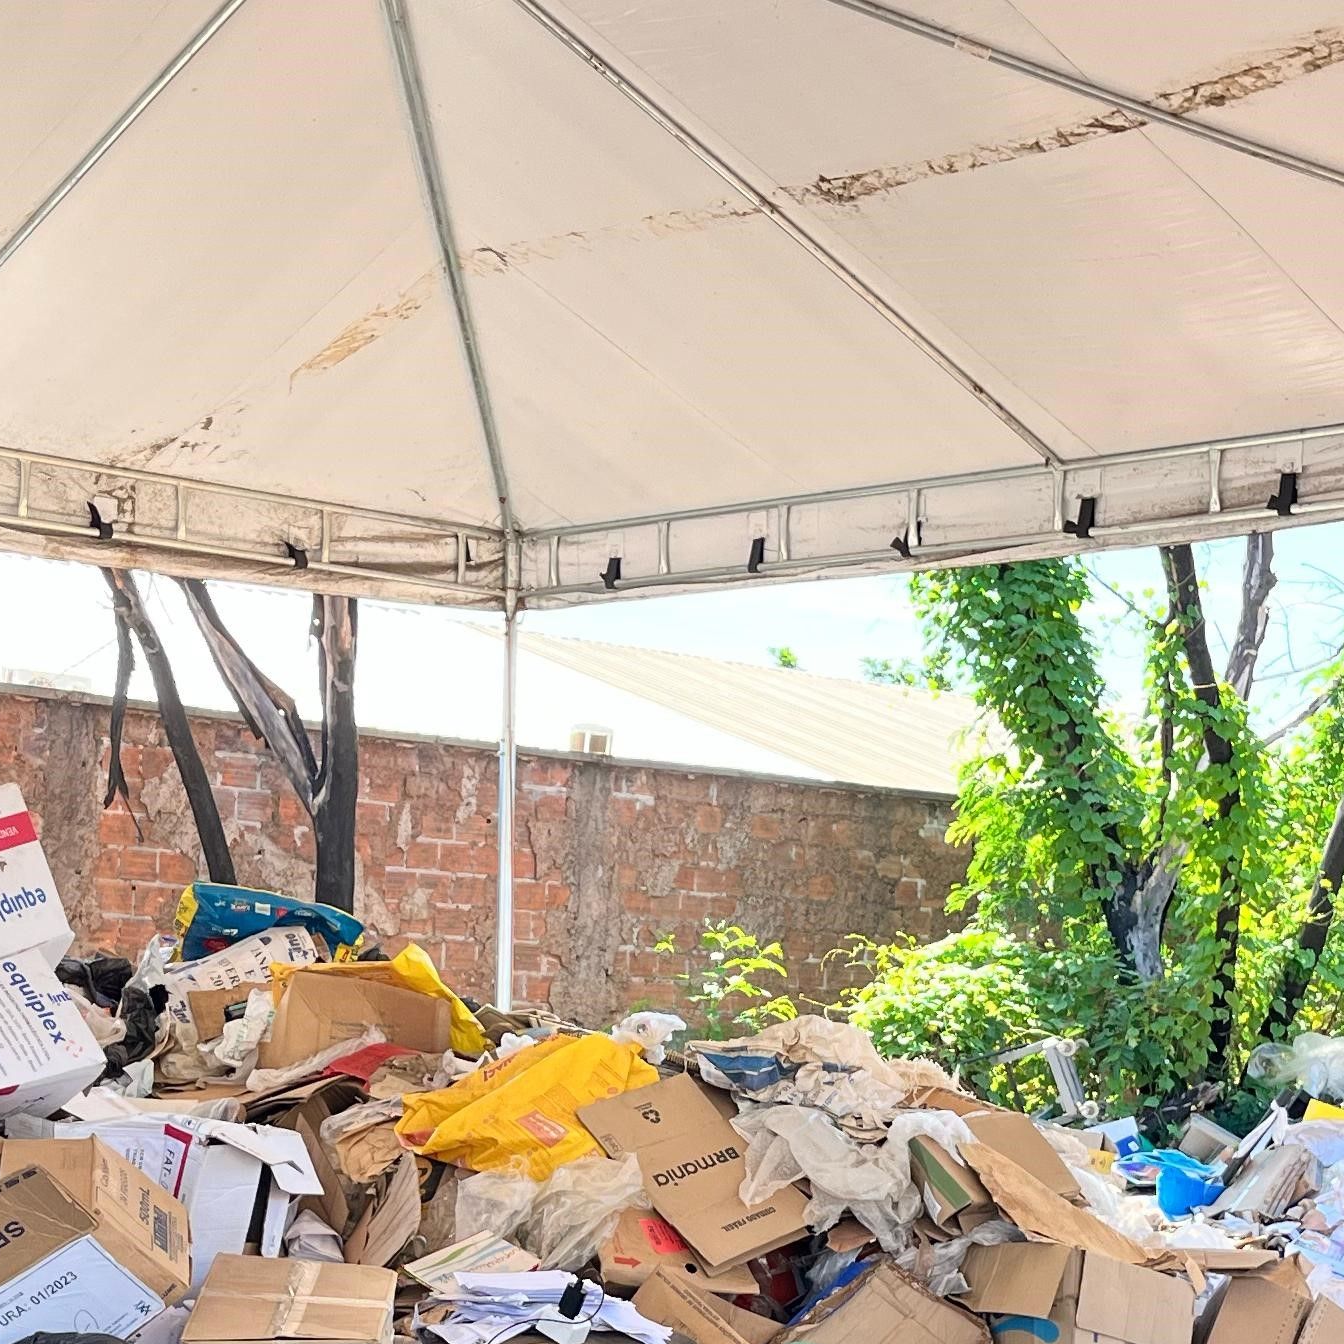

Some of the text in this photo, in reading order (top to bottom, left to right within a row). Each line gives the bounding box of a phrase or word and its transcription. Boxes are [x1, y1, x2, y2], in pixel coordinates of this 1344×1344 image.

[3, 961, 66, 1044] equiplex
[652, 1147, 740, 1187] BRmania
[30, 1271, 78, 1305] 01/2023
